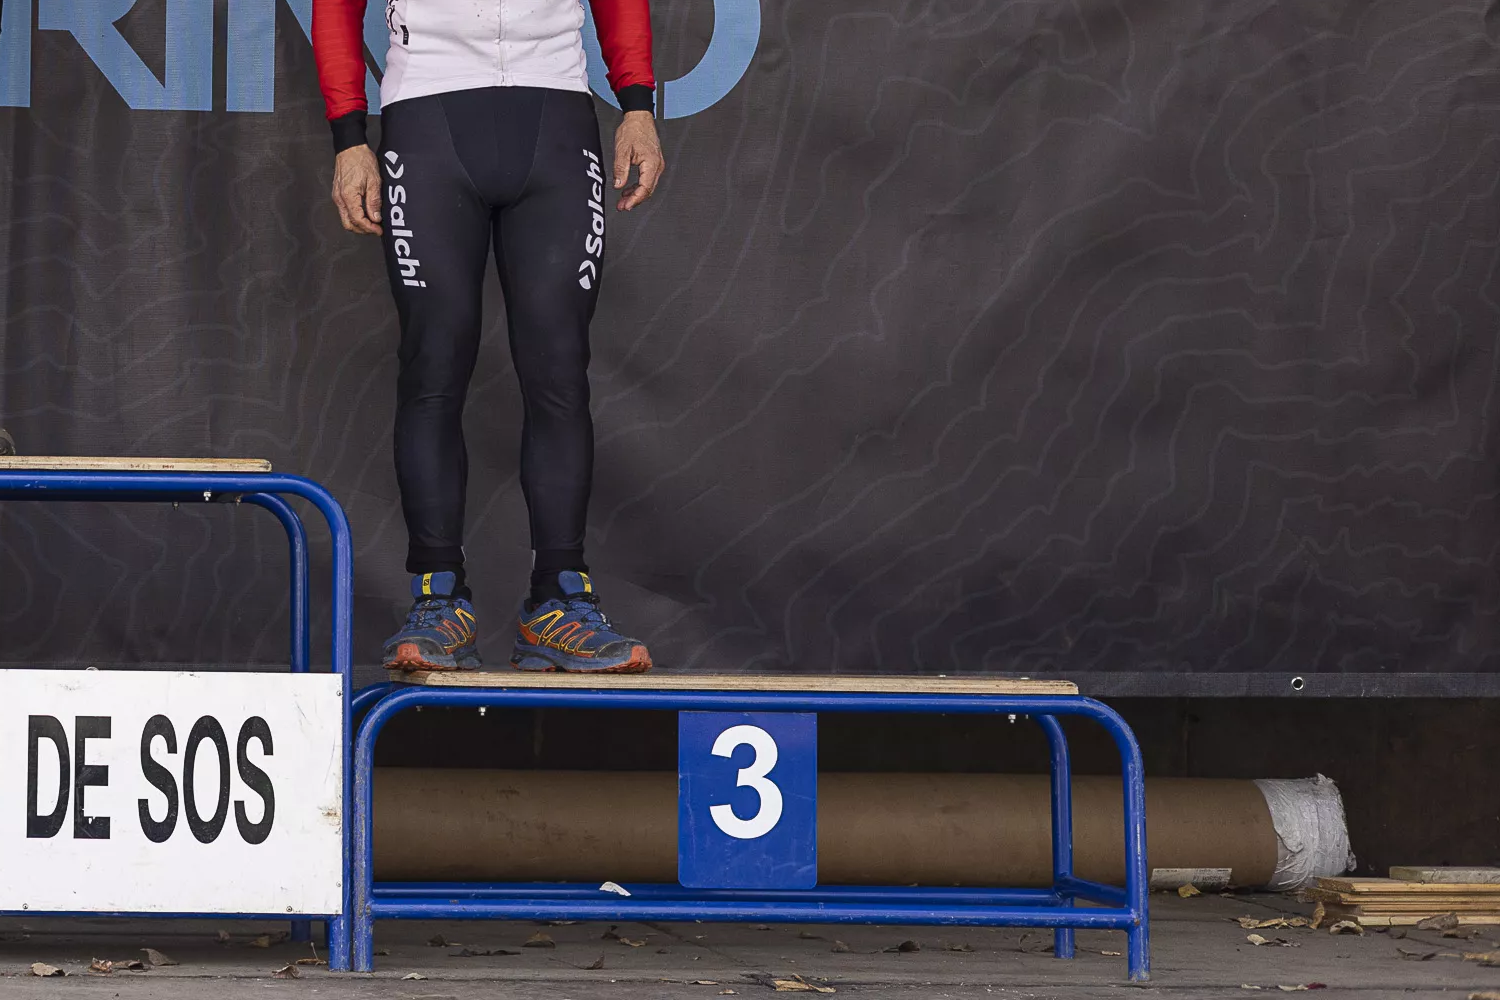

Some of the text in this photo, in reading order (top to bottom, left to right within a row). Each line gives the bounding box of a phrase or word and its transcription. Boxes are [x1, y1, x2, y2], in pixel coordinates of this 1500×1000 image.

[388, 184, 427, 288] Salchi
[582, 149, 605, 258] Salchi
[26, 715, 111, 839] DE
[138, 714, 275, 844] SOS
[709, 725, 783, 839] 3
